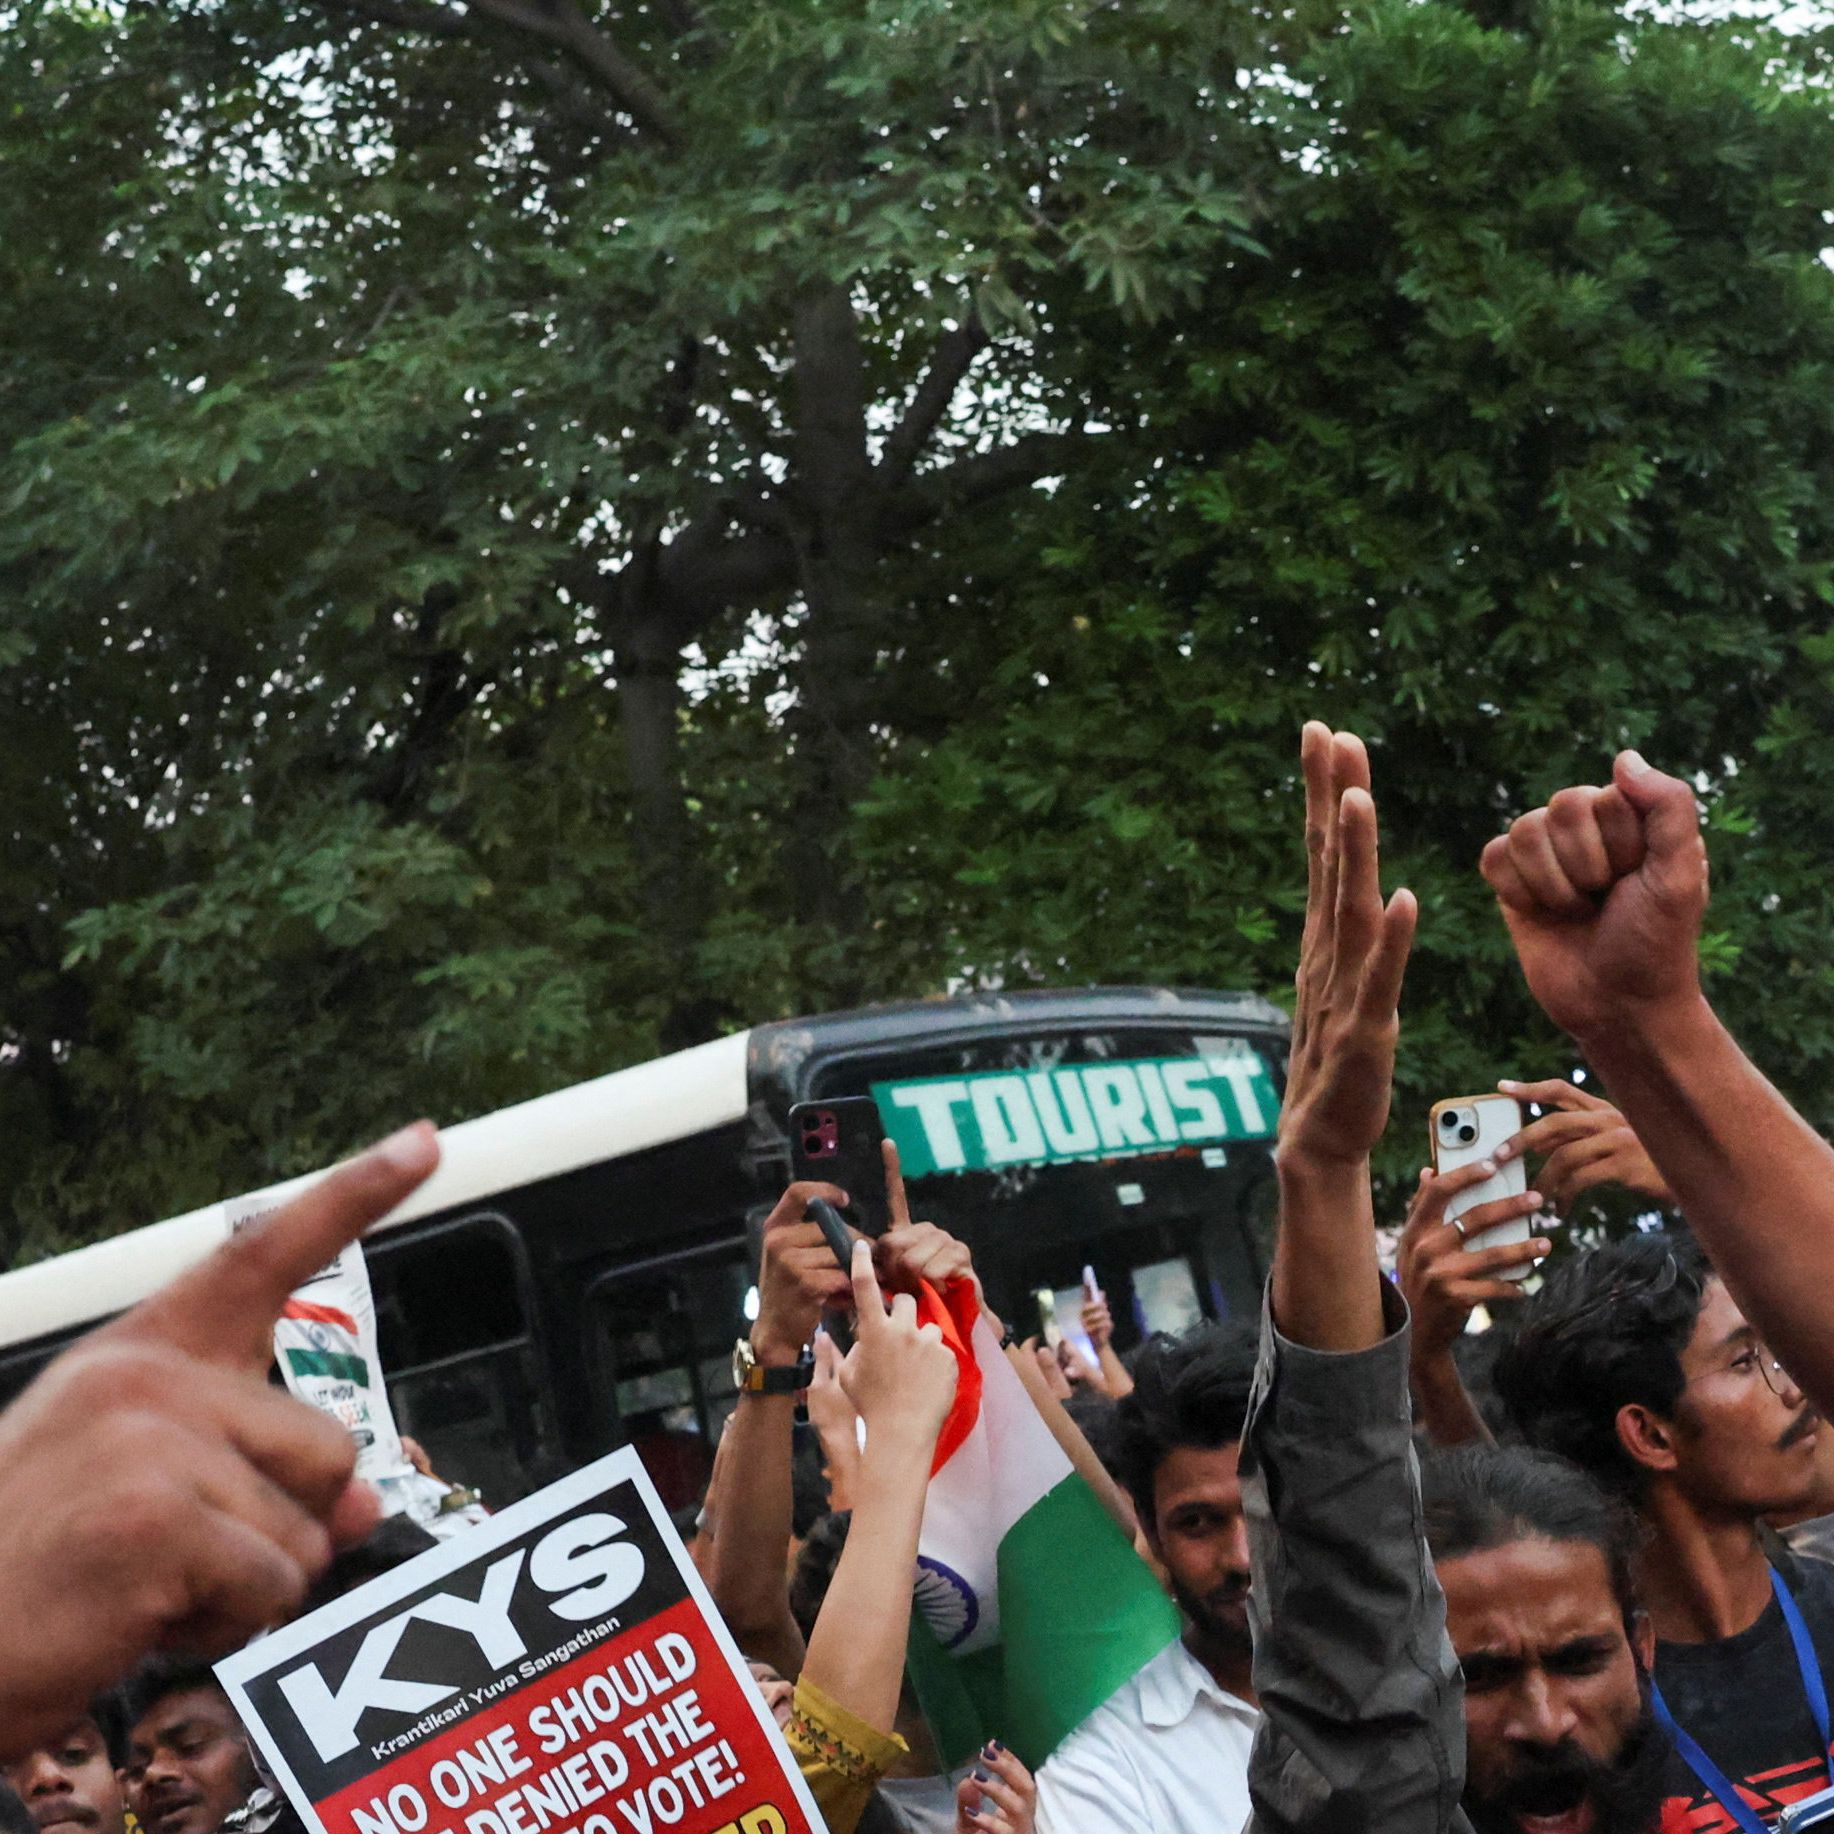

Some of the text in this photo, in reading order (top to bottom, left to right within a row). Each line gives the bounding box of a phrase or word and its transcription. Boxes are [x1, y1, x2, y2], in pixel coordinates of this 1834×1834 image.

[891, 1056, 1267, 1170] TOURIST
[277, 1512, 645, 1765] KYS
[371, 1616, 621, 1760] Krantikari Yuva Sangathan
[429, 1723, 533, 1809] ONE
[528, 1632, 697, 1754] SHOULD
[624, 1689, 715, 1767] THE
